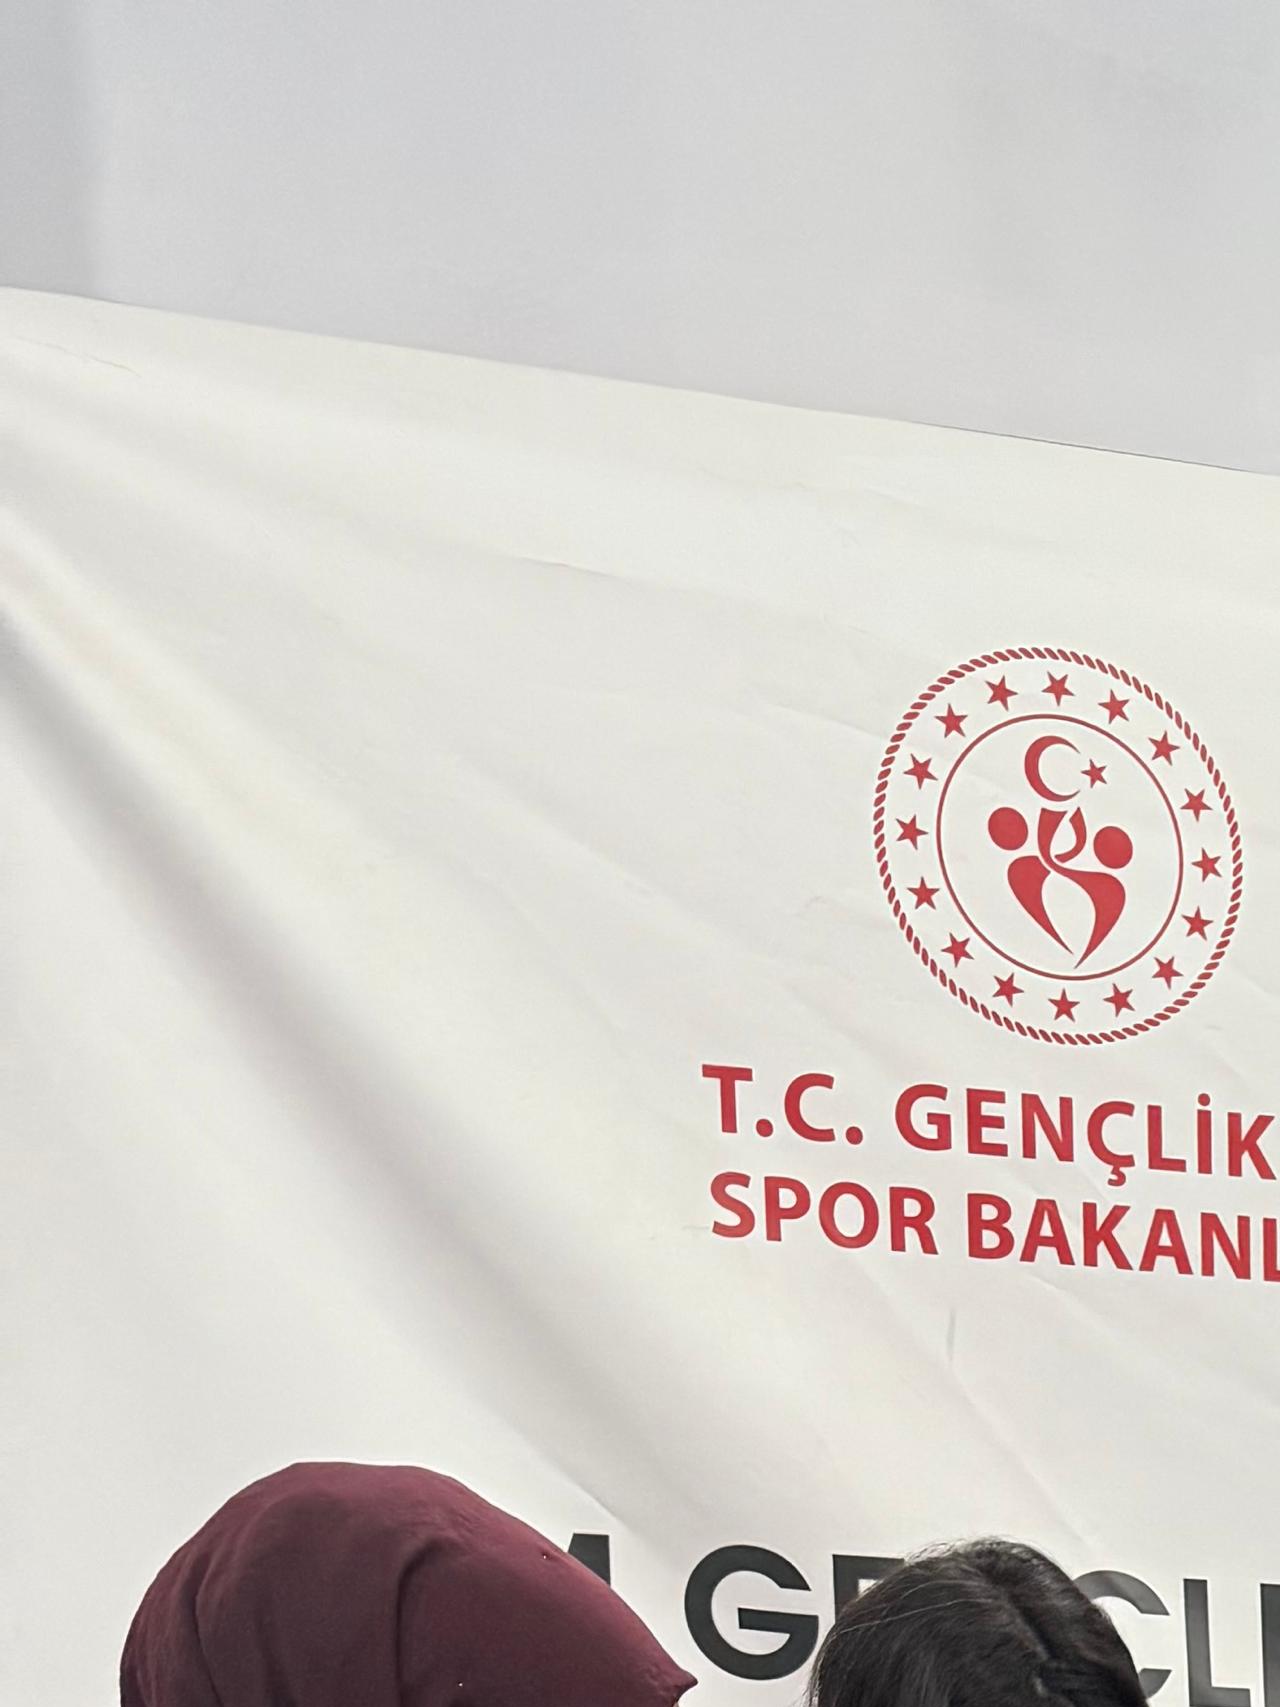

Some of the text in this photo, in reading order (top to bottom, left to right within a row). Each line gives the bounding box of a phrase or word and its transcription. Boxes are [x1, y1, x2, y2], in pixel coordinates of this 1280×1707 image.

[701, 1063, 864, 1146] T.C.
[894, 1082, 1277, 1186] GENÇLİK
[710, 1171, 939, 1255] SPOR
